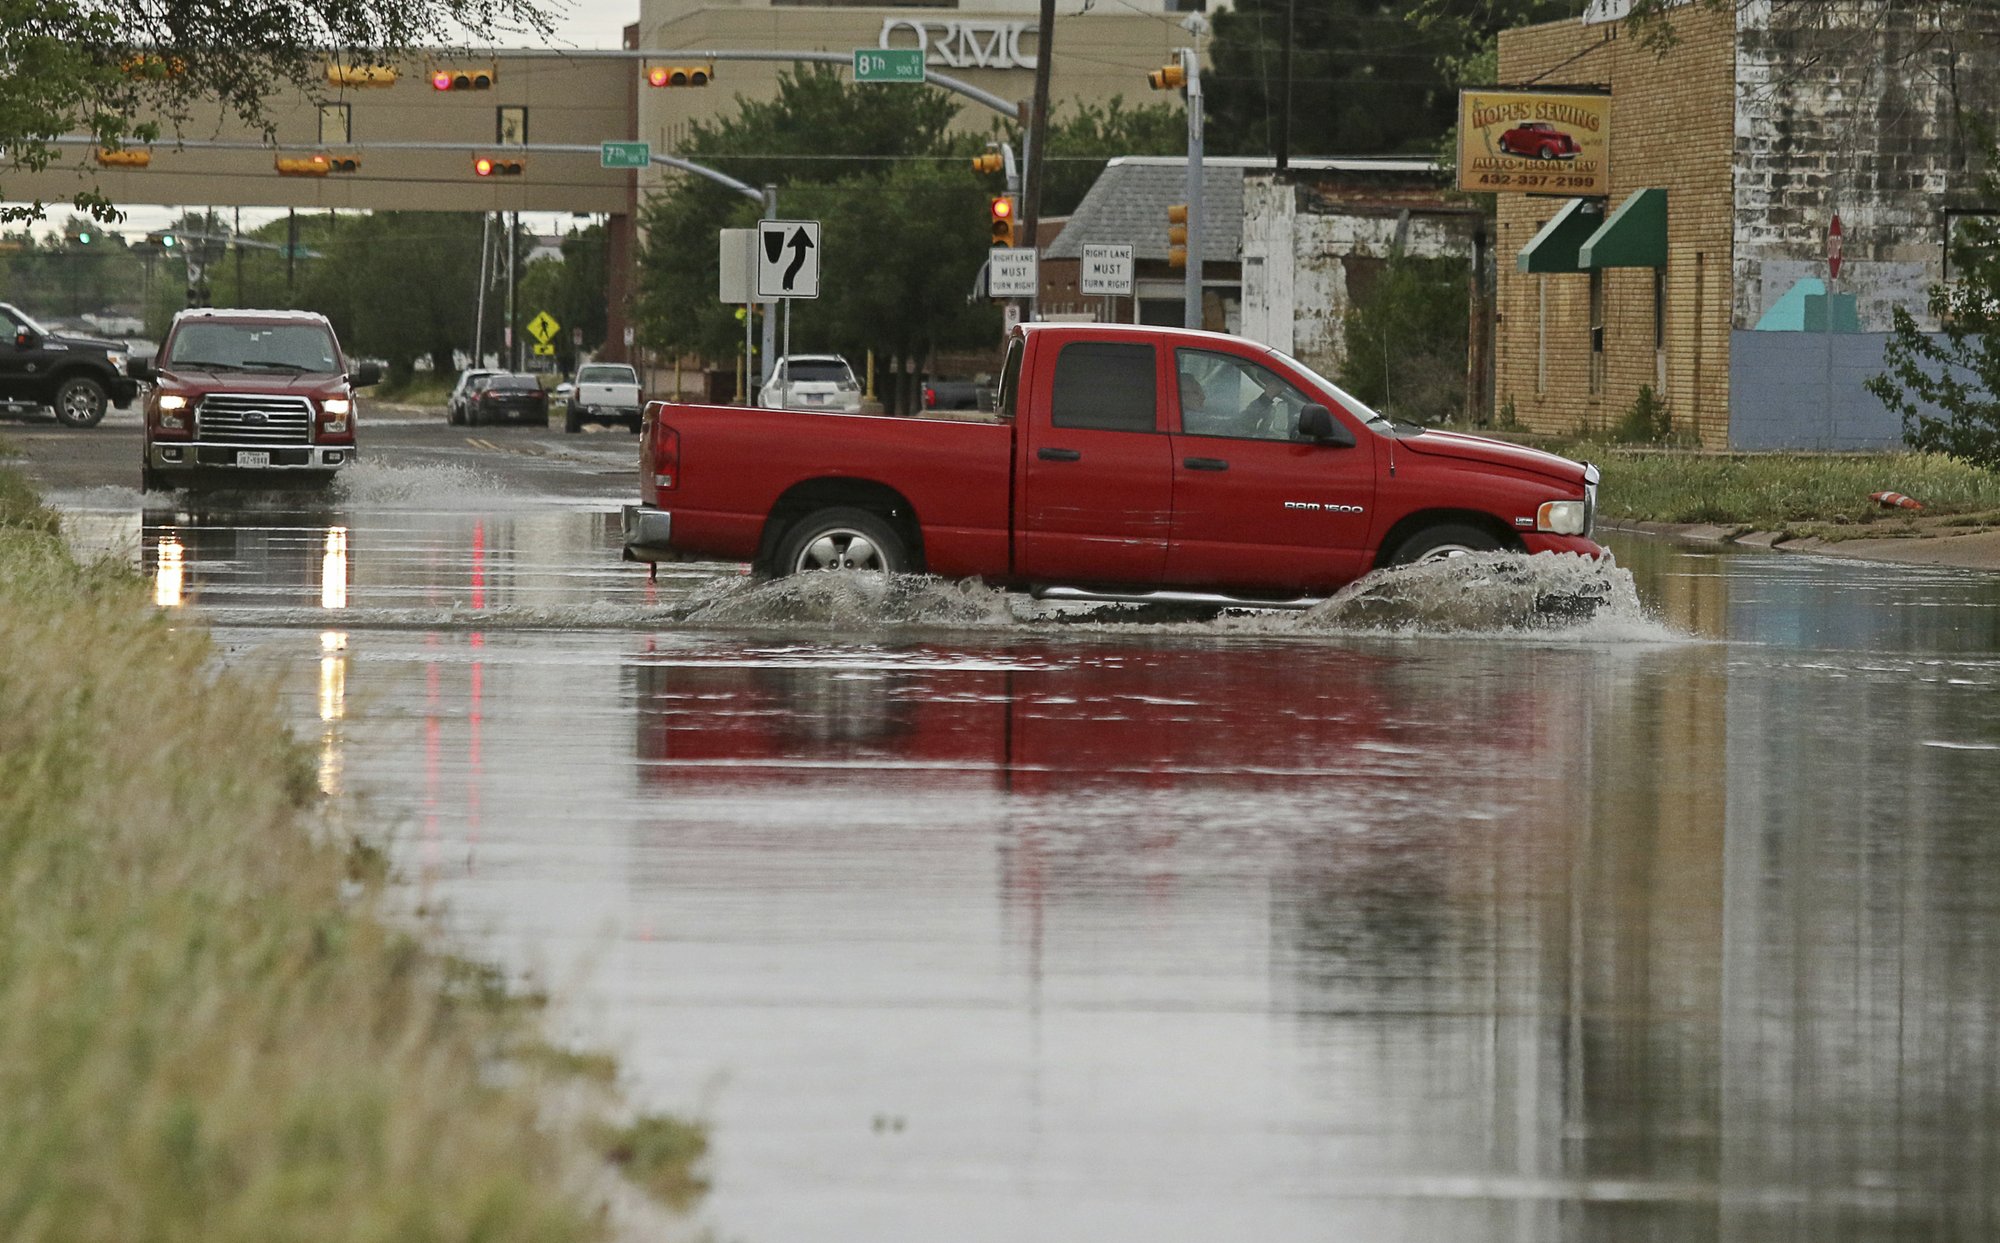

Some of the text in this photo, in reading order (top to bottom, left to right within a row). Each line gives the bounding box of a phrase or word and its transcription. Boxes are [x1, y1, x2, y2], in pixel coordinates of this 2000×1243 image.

[1473, 102, 1600, 132] HOPE'S SEWING
[1472, 157, 1598, 172] AUTO BOAT RV
[1479, 174, 1595, 188] 432-337-2199
[993, 254, 1033, 263] RIGHT LANE
[1085, 250, 1130, 260] RIGHT LANE
[1001, 267, 1026, 277] MUST
[1093, 264, 1120, 274] MUST
[993, 282, 1034, 290] TURN RIGHT
[1084, 279, 1130, 289] TURN RIGHT
[1284, 501, 1363, 513] RAM 1500
